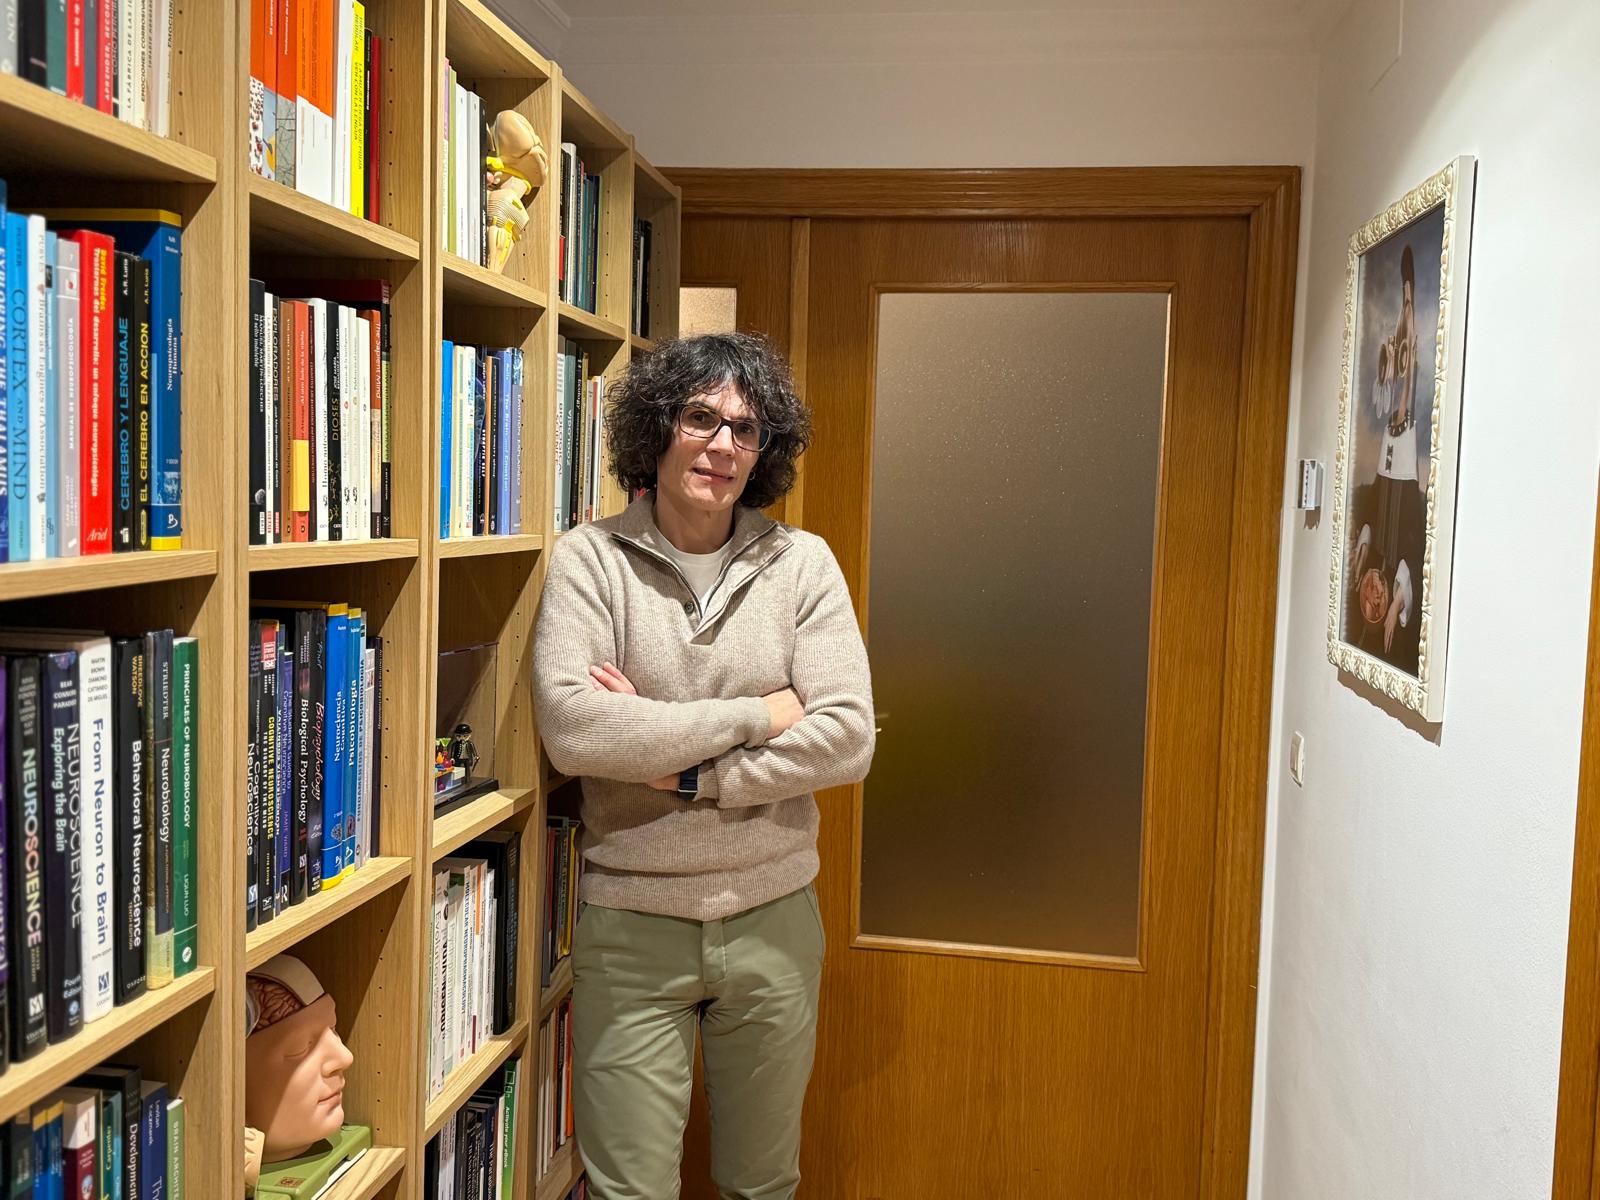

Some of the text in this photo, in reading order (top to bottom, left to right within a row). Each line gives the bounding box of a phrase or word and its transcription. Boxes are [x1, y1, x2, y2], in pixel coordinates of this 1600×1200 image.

[121, 258, 129, 279] Luria
[67, 317, 75, 399] NEUROPSICOLOGÍA
[92, 367, 98, 380] un
[165, 318, 175, 392] Neuropsicología
[170, 337, 178, 375] Humana
[272, 307, 280, 402] EXPLORADORES
[372, 322, 382, 399] The Sapient Mind
[12, 288, 28, 501] CORTEX AND MIND
[69, 401, 75, 413] DE
[91, 381, 99, 420] enfoque
[118, 317, 130, 511] CEREBRO Y LENGUAJE
[140, 322, 149, 503] EL CEREBRO EN ACCION
[332, 397, 340, 441] DIOSES
[90, 421, 98, 497] neuropsicológico
[60, 680, 73, 689] BEAR
[88, 675, 107, 684] DIAMOND
[92, 718, 104, 773] From
[183, 663, 191, 828] PRINCIPLES OF NEUROBIOLOGY
[298, 698, 309, 823] Biological Psychology
[311, 701, 325, 801] Biopsychology
[333, 690, 342, 762] Neurociencia
[348, 679, 358, 767] Psicobiología
[358, 735, 364, 749] DE
[51, 727, 67, 852] Exploring the Brain
[159, 747, 171, 843] Neurobiology
[246, 742, 255, 856] Neuroscience
[252, 761, 261, 836] Cognitive
[261, 780, 267, 790] OF
[266, 716, 276, 840] COGNITIVE NEUROSCIENCE
[23, 747, 43, 948] NEUROSCIENCE
[66, 722, 81, 929] NEUROSCIENCE
[94, 779, 106, 857] Neuron
[132, 739, 143, 947] Behavioral Neuroscience
[95, 862, 106, 886] to
[96, 891, 109, 945] Brain
